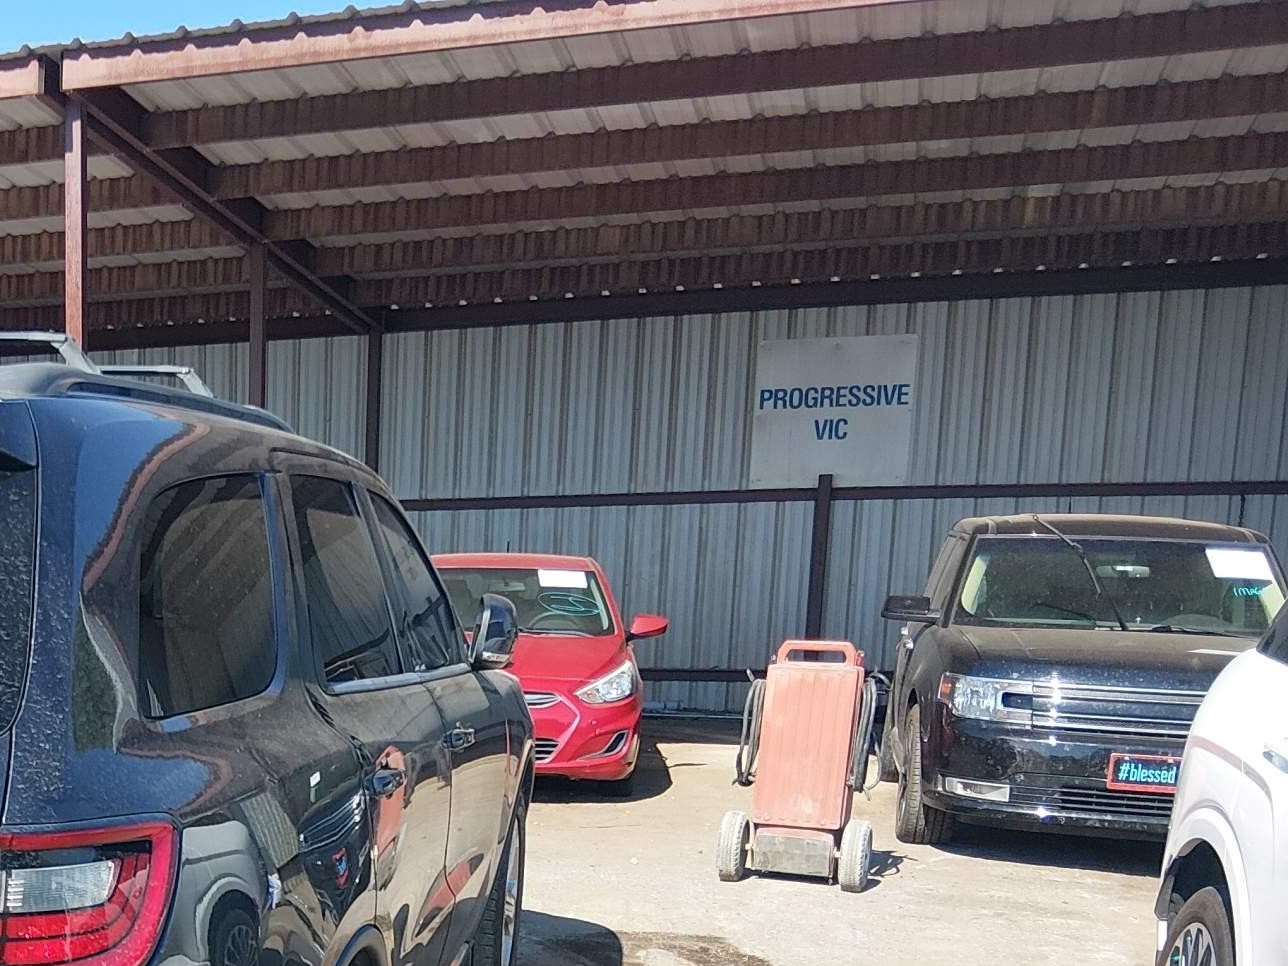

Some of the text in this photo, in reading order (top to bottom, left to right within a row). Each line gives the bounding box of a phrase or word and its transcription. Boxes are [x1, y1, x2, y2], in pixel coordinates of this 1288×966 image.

[759, 384, 911, 410] PROGRESSIVE
[814, 418, 848, 440] VIC
[1118, 762, 1177, 784] #blessed
